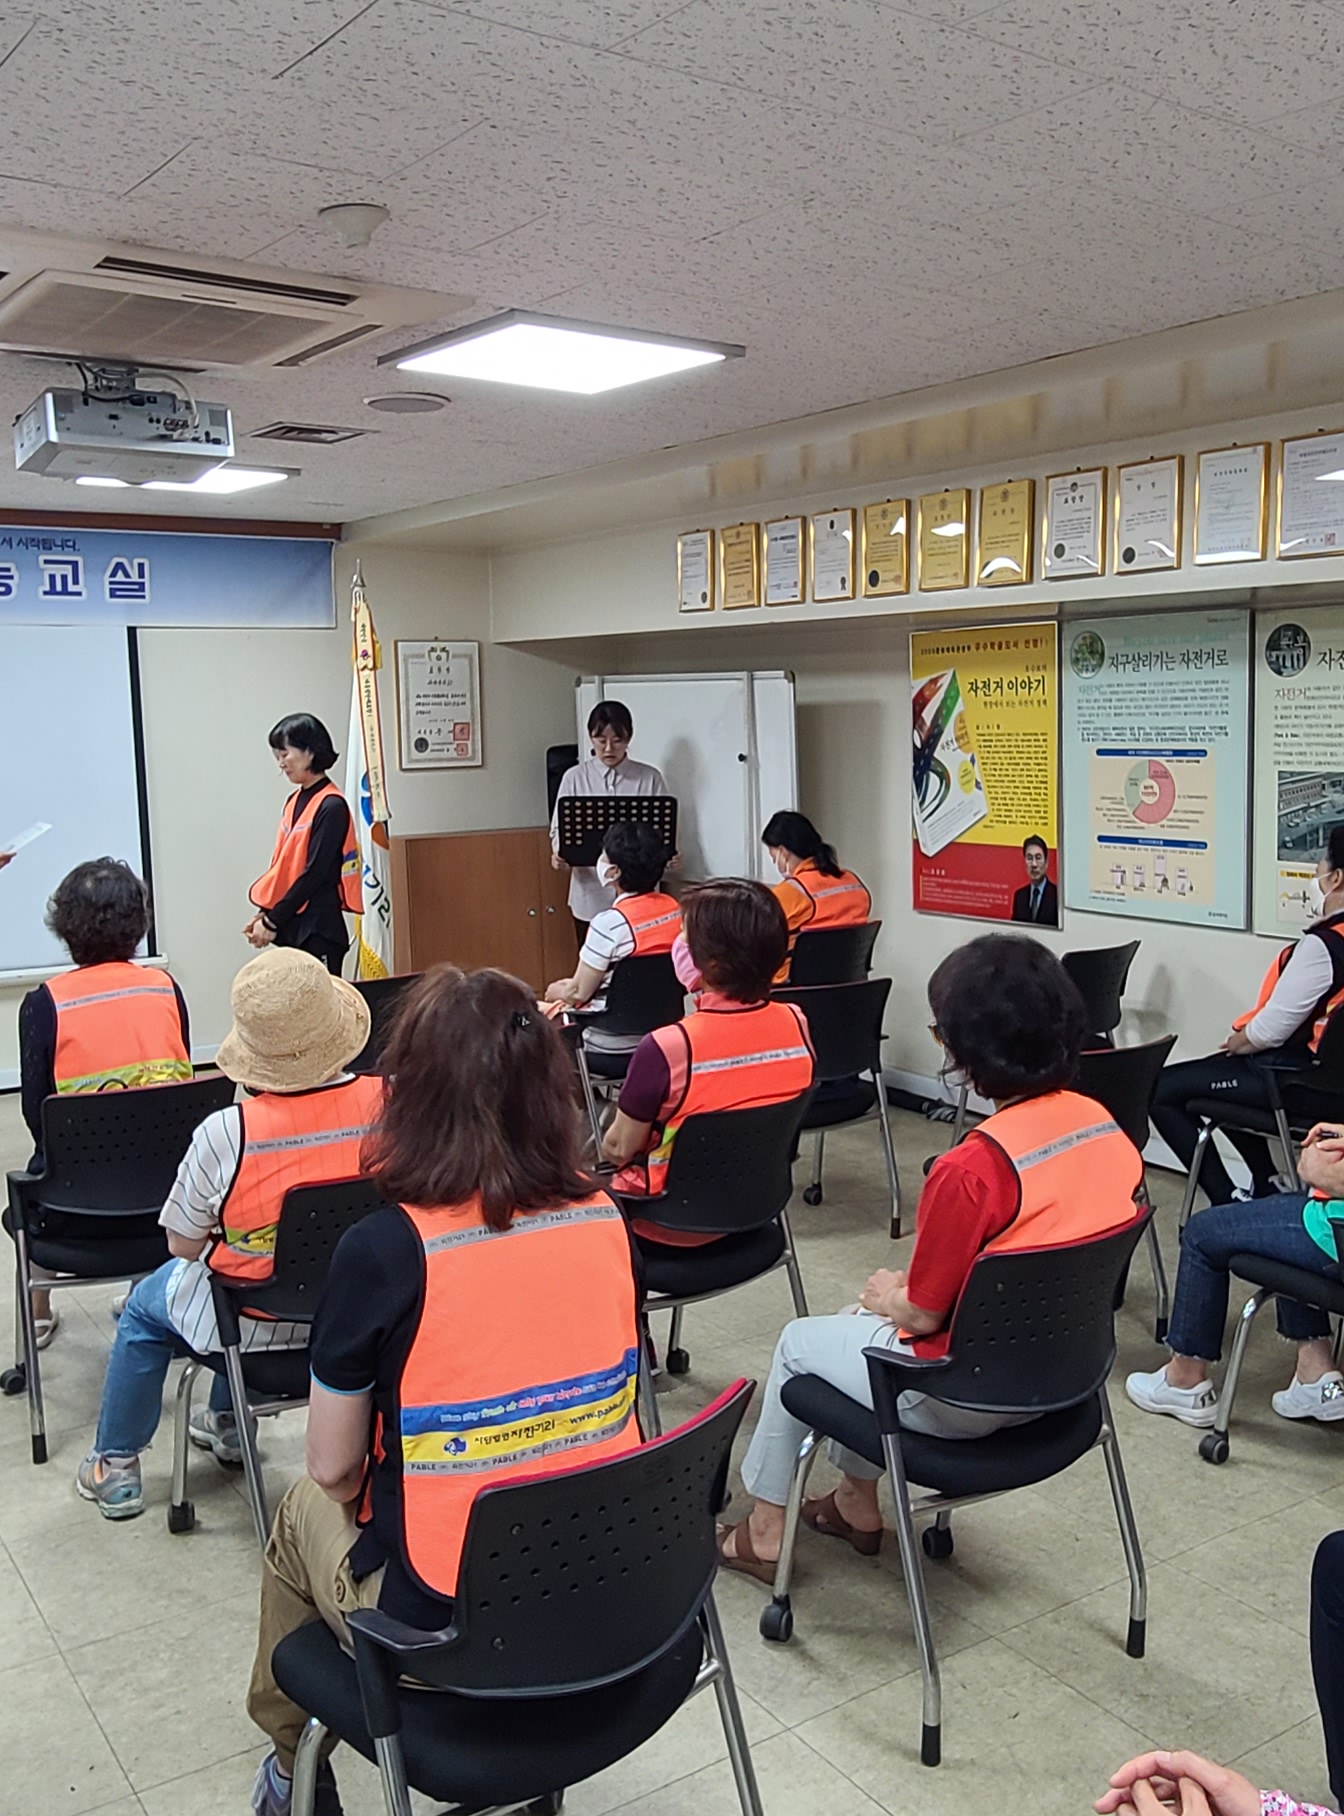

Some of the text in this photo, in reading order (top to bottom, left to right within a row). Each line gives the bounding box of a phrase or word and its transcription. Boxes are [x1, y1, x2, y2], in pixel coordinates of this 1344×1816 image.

[16, 537, 81, 552] 시작됩니다.
[1108, 648, 1229, 674] 지구살리기는 자전거로
[967, 675, 1045, 698] 자전거 이야기
[1274, 687, 1306, 700] 자전거
[1210, 1079, 1238, 1090] PABLE
[550, 1213, 573, 1222] PABLE
[492, 1454, 518, 1466] PABLE
[564, 1433, 588, 1446] PABLE
